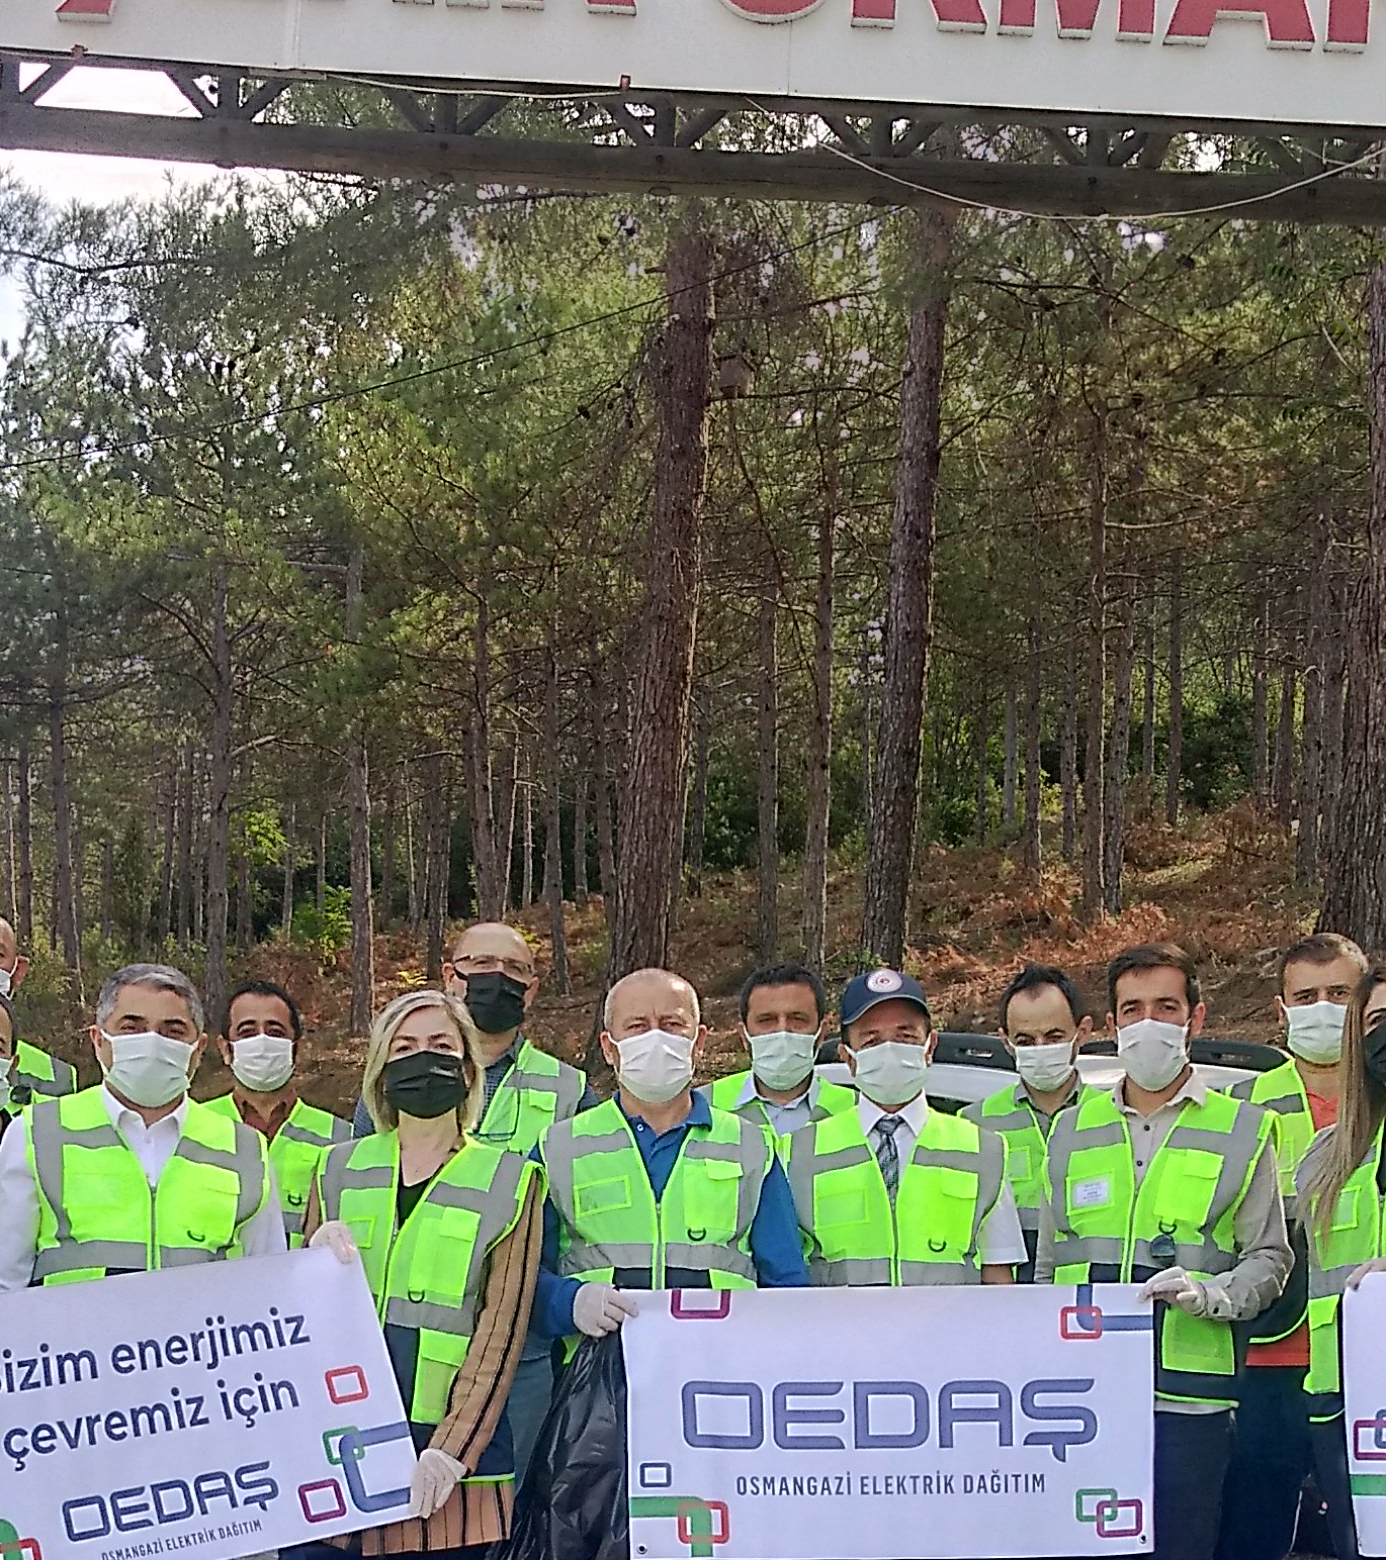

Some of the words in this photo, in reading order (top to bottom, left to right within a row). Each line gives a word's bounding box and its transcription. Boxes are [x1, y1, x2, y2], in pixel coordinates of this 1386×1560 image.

[112, 1306, 311, 1374] enerjimiz
[4, 1388, 210, 1472] çevremiz
[219, 1373, 300, 1428] için
[681, 1378, 1099, 1463] OEDAŞ
[62, 1460, 280, 1543] OEDAŞ
[735, 1470, 852, 1497] OSMANGAZİ
[859, 1468, 956, 1496] ELEKTRİK
[962, 1467, 1047, 1495] DAĞITIM
[165, 1527, 218, 1552] ELEKTRİK
[218, 1518, 263, 1540] DAĞITIM
